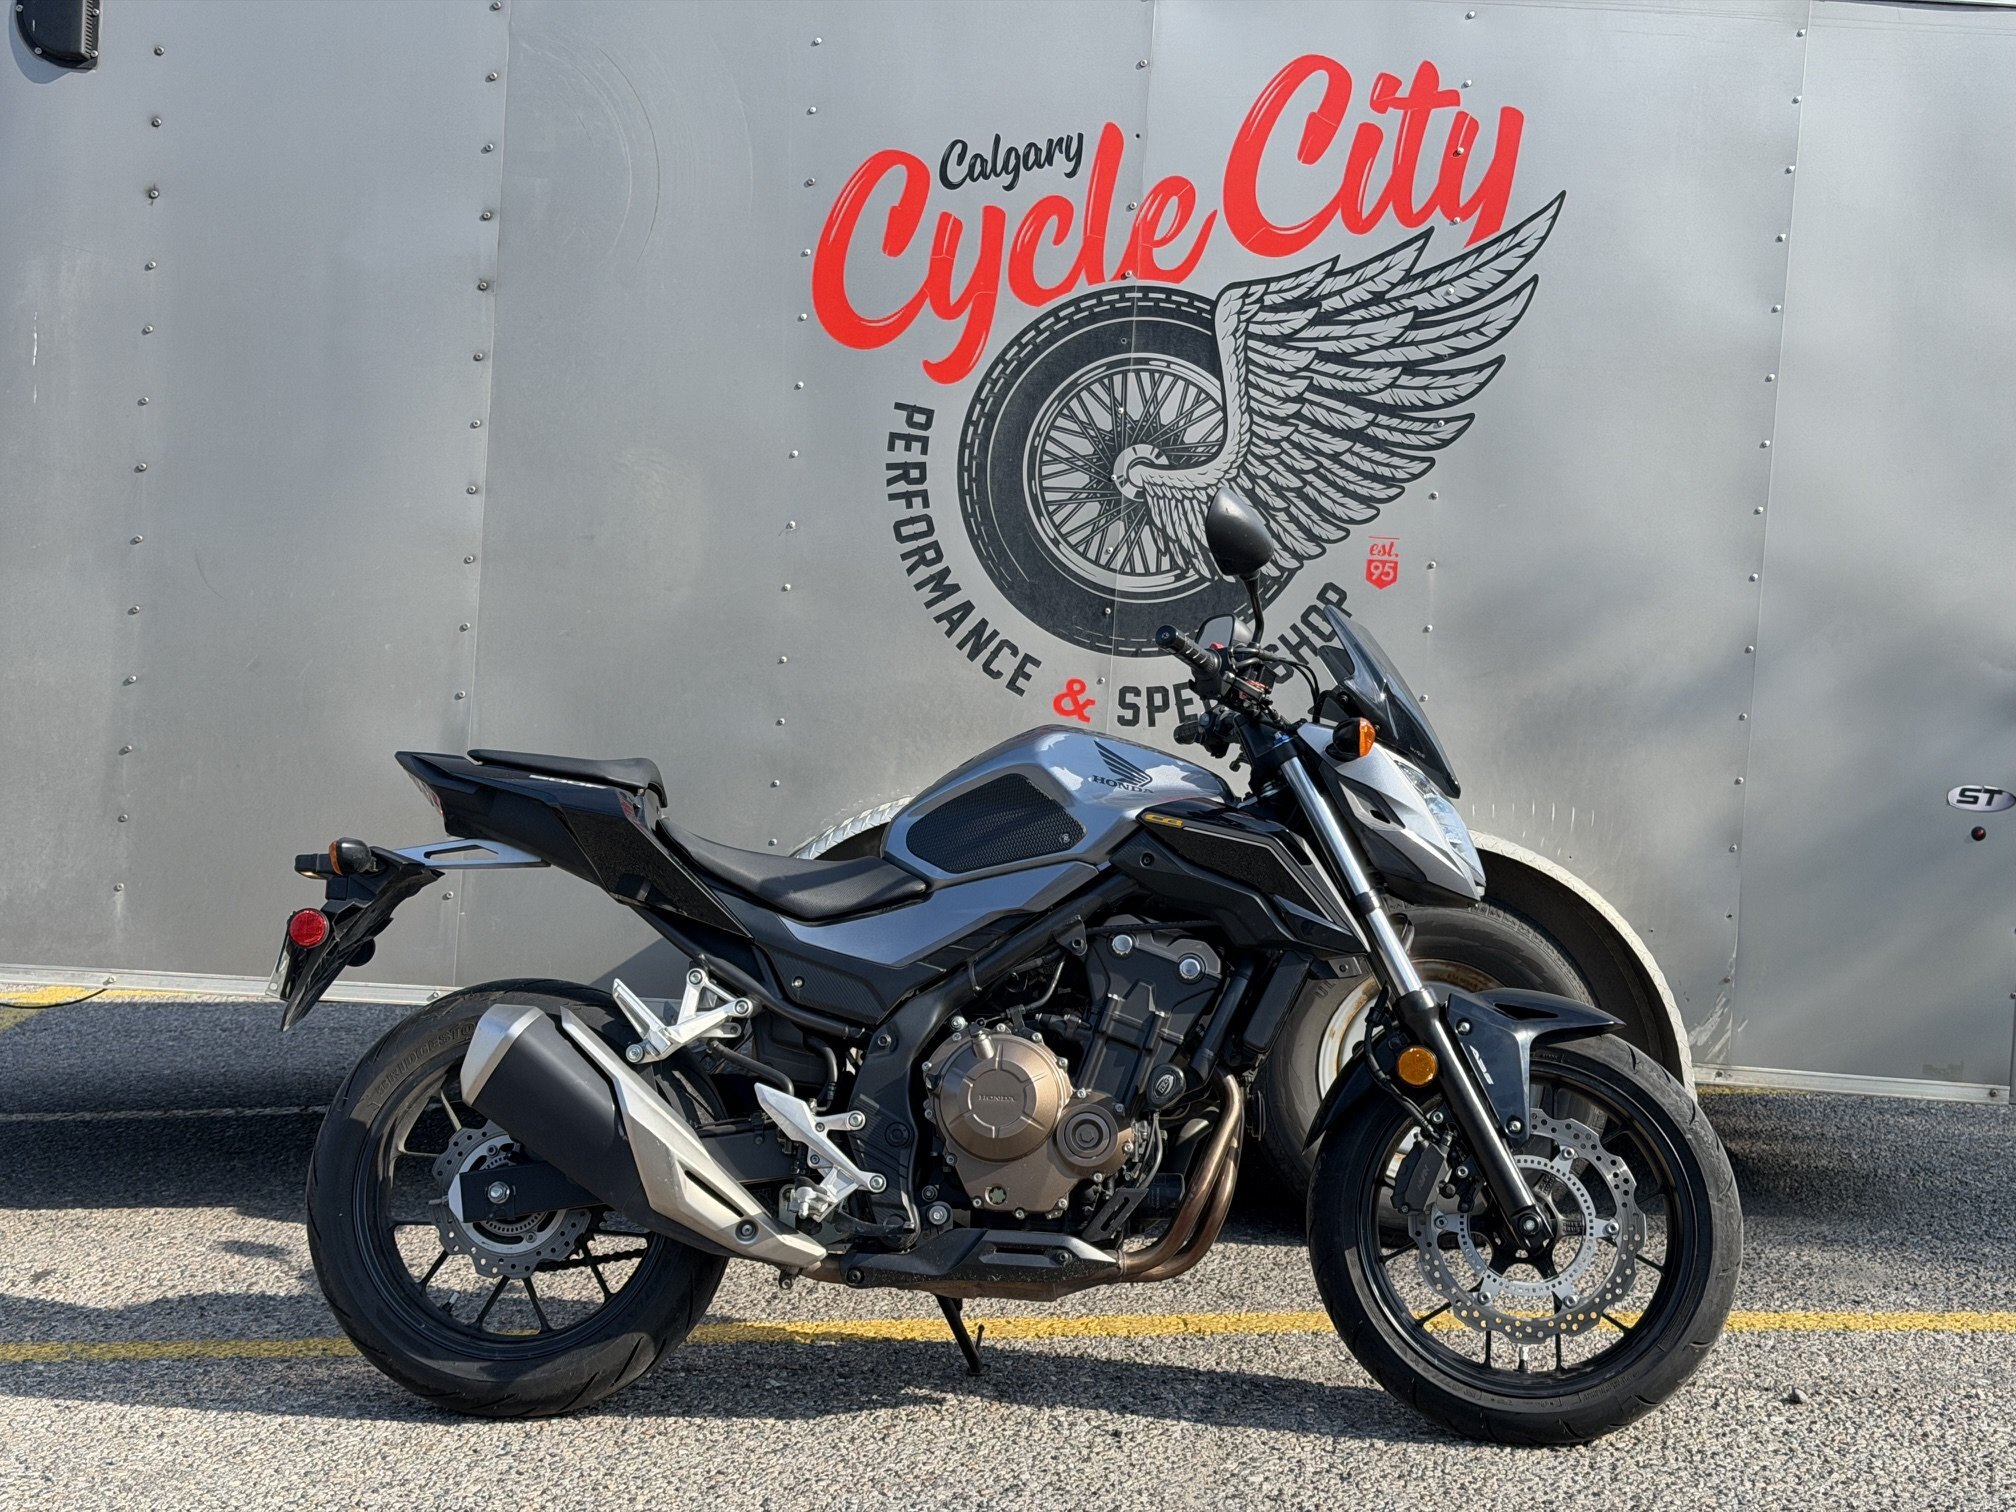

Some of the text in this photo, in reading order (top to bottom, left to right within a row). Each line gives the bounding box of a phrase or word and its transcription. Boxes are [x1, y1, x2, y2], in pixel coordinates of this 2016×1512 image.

[939, 132, 1083, 191] Calgary
[812, 54, 1524, 384] Cycle City
[885, 401, 1353, 728] PERFORMANCE & SPE SHOP
[1370, 561, 1395, 581] 95
[1092, 775, 1154, 794] HONDA
[1956, 787, 2003, 807] ST
[374, 1021, 477, 1096] BRIDGESTO
[1469, 1044, 1495, 1085] ABS
